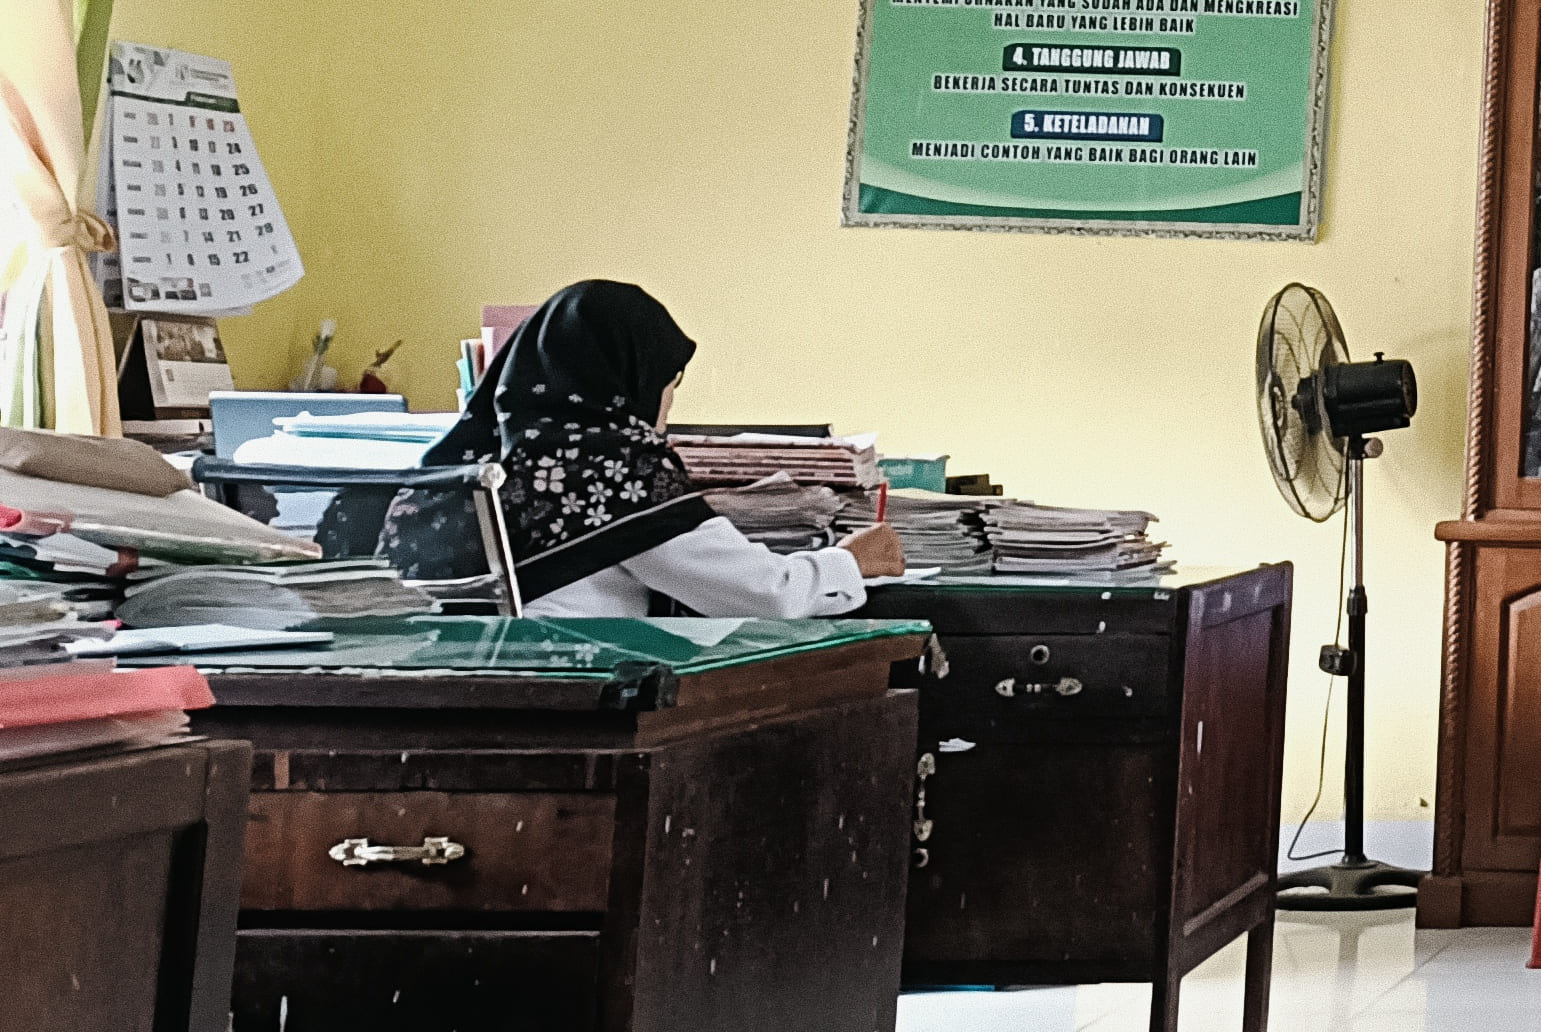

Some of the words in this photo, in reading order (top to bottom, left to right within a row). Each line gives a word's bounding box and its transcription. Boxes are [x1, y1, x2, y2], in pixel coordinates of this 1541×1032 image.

[994, 13, 1020, 28] HAL
[1025, 13, 1066, 29] BARU
[1071, 15, 1108, 30] YANG
[1113, 16, 1154, 32] LEBIH
[1159, 18, 1194, 33] BAIK
[1012, 46, 1028, 66] 4.
[1031, 47, 1114, 68] TANGGUNG
[1117, 50, 1171, 70] JAWAB
[933, 75, 996, 91] BEKERJA
[1001, 77, 1058, 93] SECARA
[1064, 79, 1120, 95] TUNTAS
[1124, 81, 1154, 96] DAN
[1159, 82, 1245, 99] KONSEKUEN
[1024, 113, 1040, 133] 5.
[1042, 114, 1150, 136] KETELADANAN
[226, 142, 242, 155] 24
[911, 142, 975, 158] MENJADI
[980, 144, 1040, 160] CONTOH
[1046, 146, 1083, 162] YANG
[1088, 147, 1124, 162] BAIK
[1128, 149, 1164, 164] BAGI
[1169, 149, 1219, 165] ORANG
[1223, 151, 1257, 166] LAIN
[232, 163, 250, 176] 25
[239, 183, 259, 197] 26
[219, 208, 236, 221] 20
[248, 203, 265, 217] 27
[226, 230, 242, 243] 21
[255, 222, 274, 237] 28
[233, 251, 250, 264] 22
